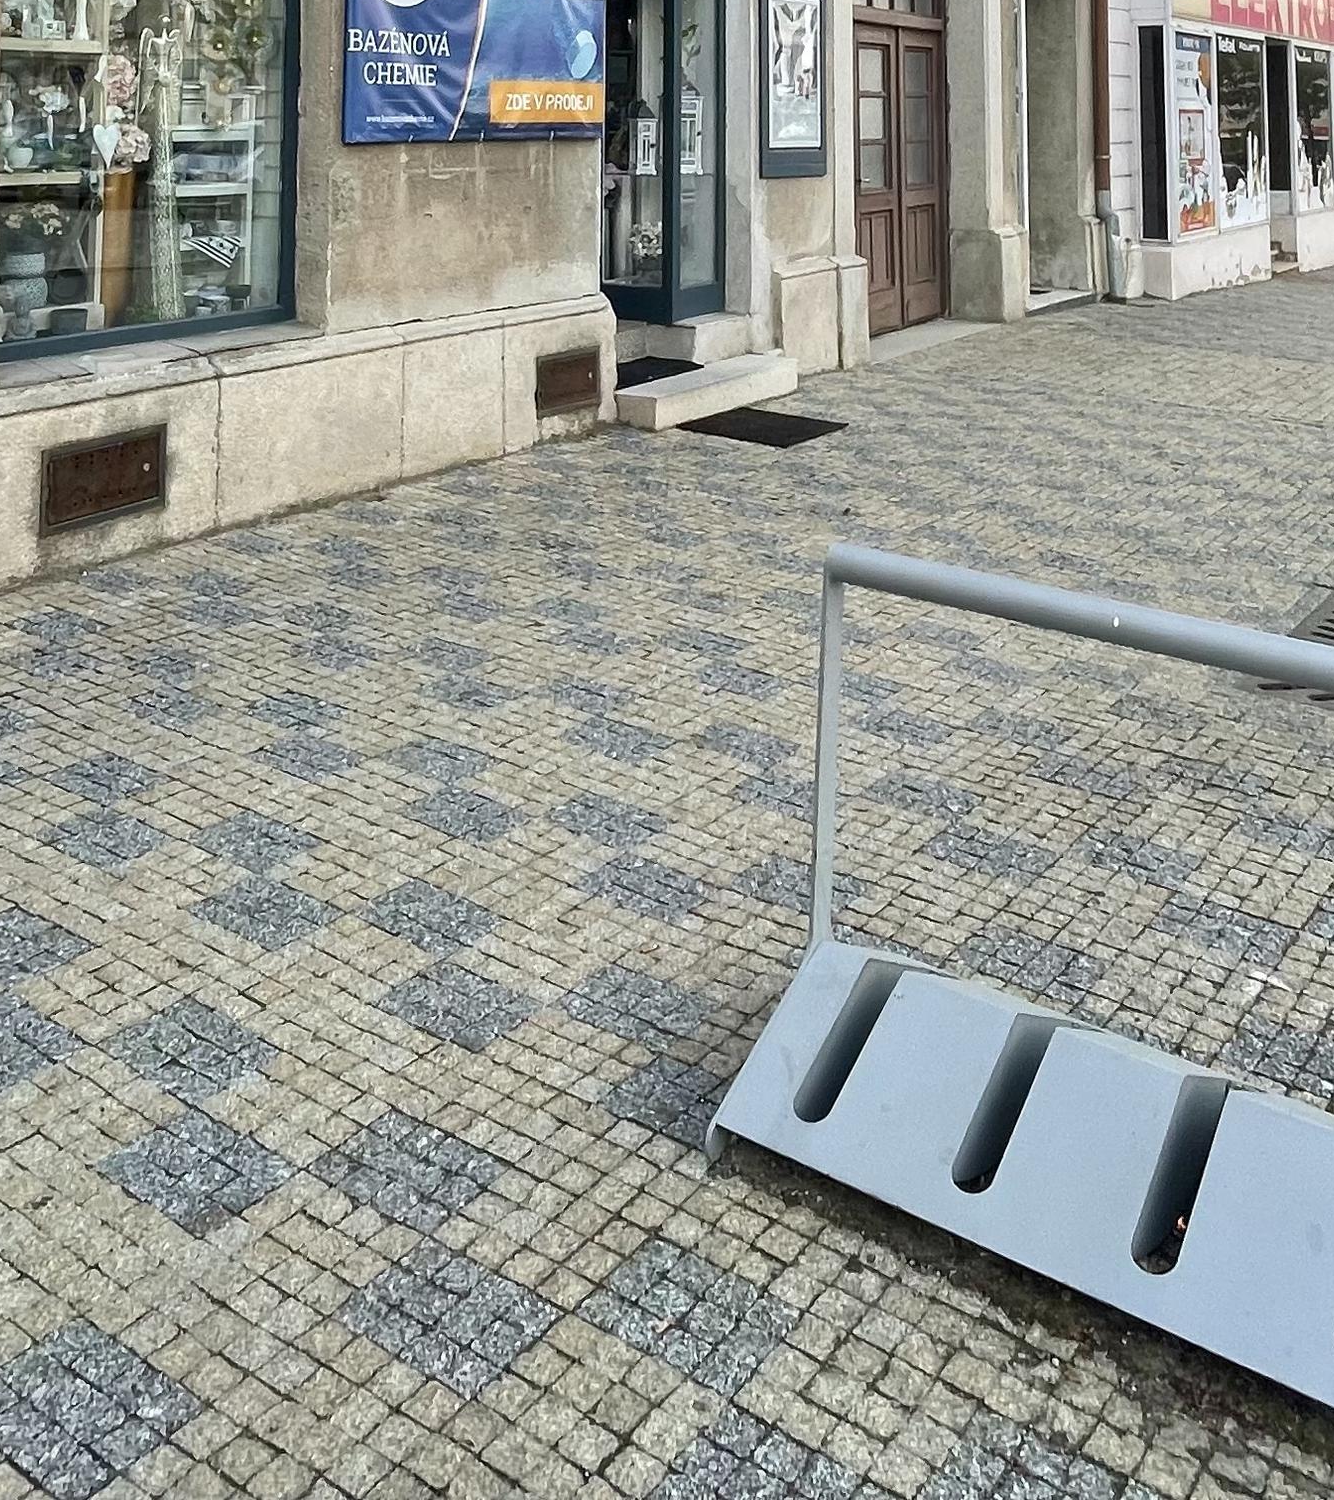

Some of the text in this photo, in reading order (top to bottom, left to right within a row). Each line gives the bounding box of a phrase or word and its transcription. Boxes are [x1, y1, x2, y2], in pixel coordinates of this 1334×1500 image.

[348, 27, 451, 57] BAZÉNOVÁ
[363, 61, 438, 86] CHEMIE
[506, 93, 594, 111] ZDE V PRODEJI
